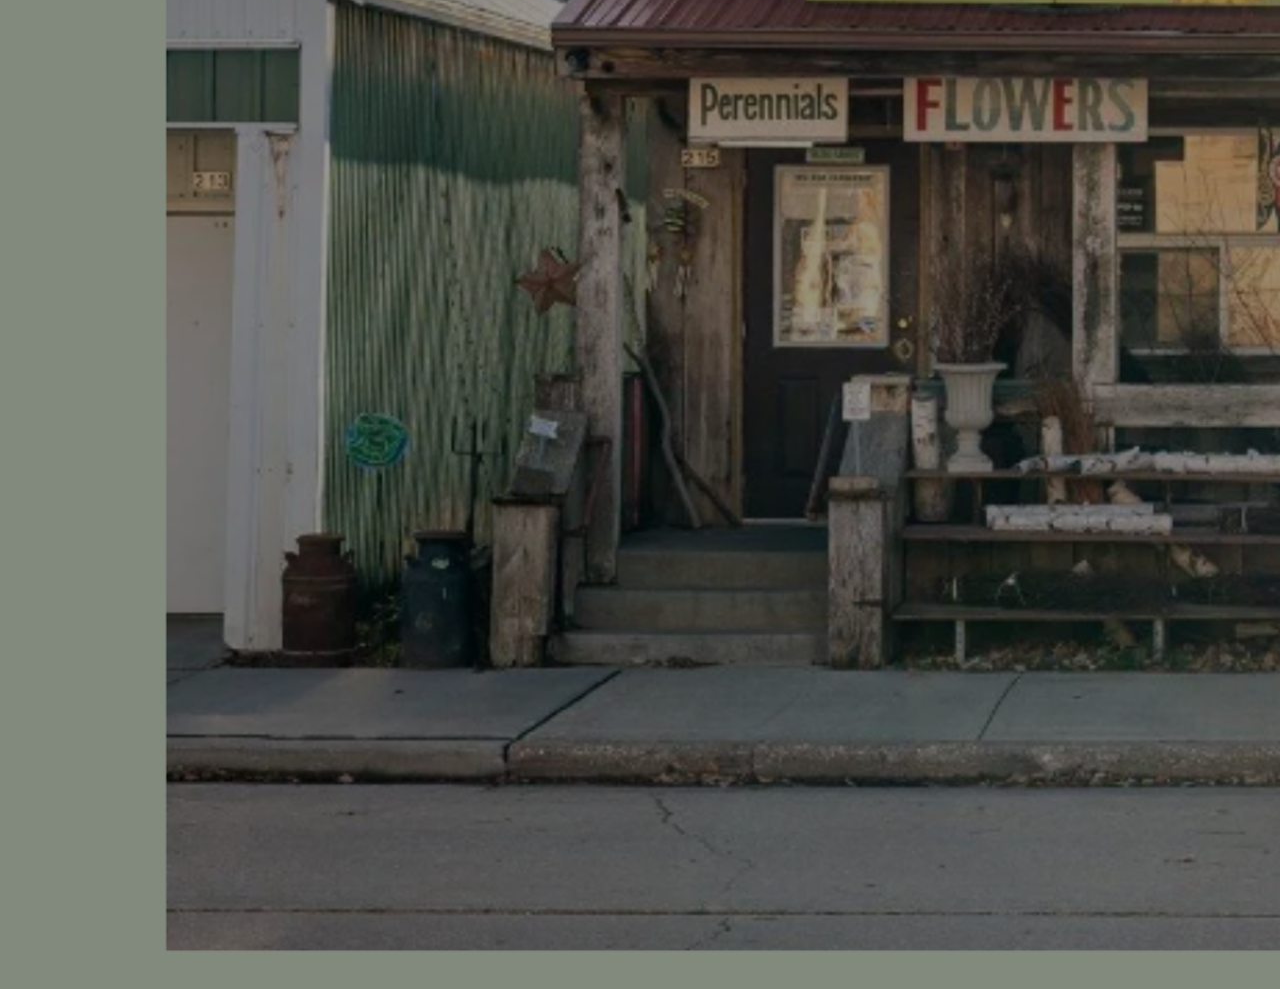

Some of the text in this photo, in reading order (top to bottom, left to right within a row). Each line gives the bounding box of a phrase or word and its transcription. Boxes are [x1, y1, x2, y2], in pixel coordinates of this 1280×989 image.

[701, 83, 838, 127] Perennials
[916, 78, 1135, 131] FLOWERS
[683, 151, 716, 165] 215
